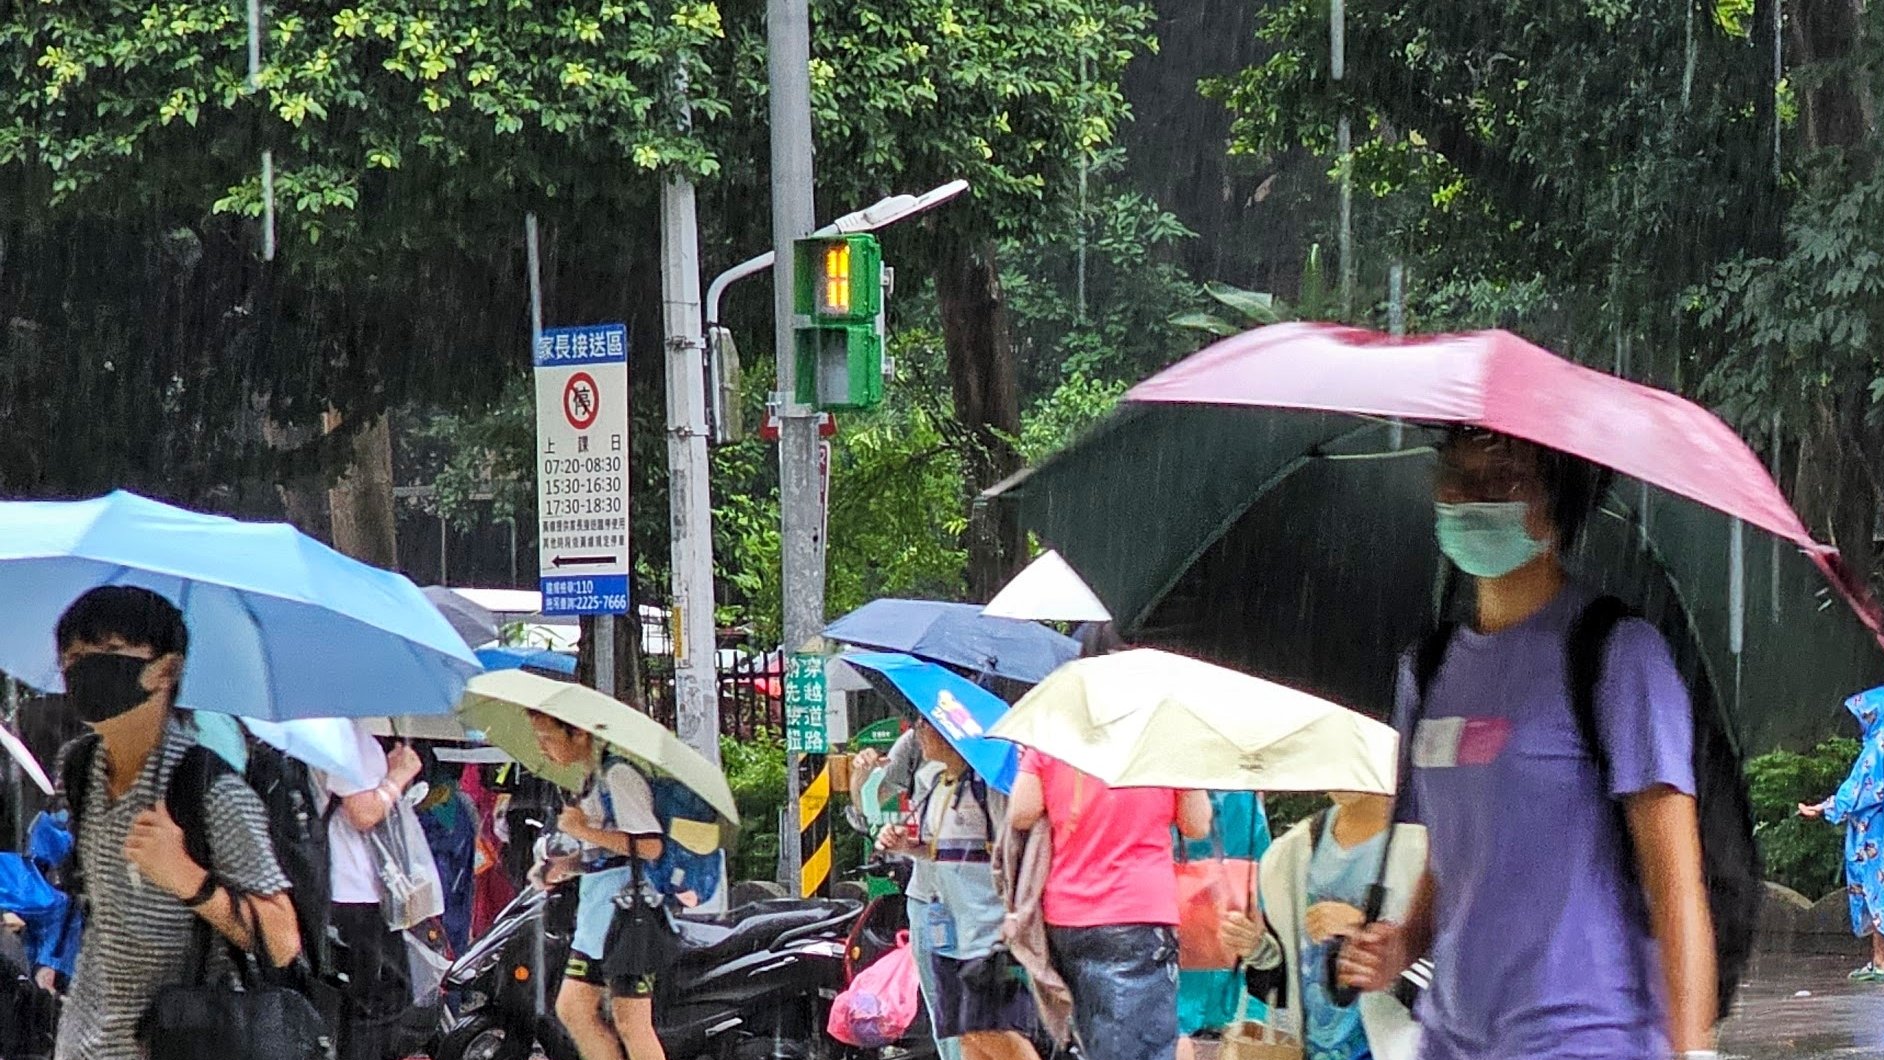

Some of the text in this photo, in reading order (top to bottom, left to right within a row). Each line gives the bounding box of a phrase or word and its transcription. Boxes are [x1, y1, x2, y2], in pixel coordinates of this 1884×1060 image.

[539, 331, 624, 360] 家長接送區
[544, 456, 621, 475] 07:20-08:30
[545, 476, 621, 495] 15:30-16:30
[546, 497, 621, 515] 17:30-18:30
